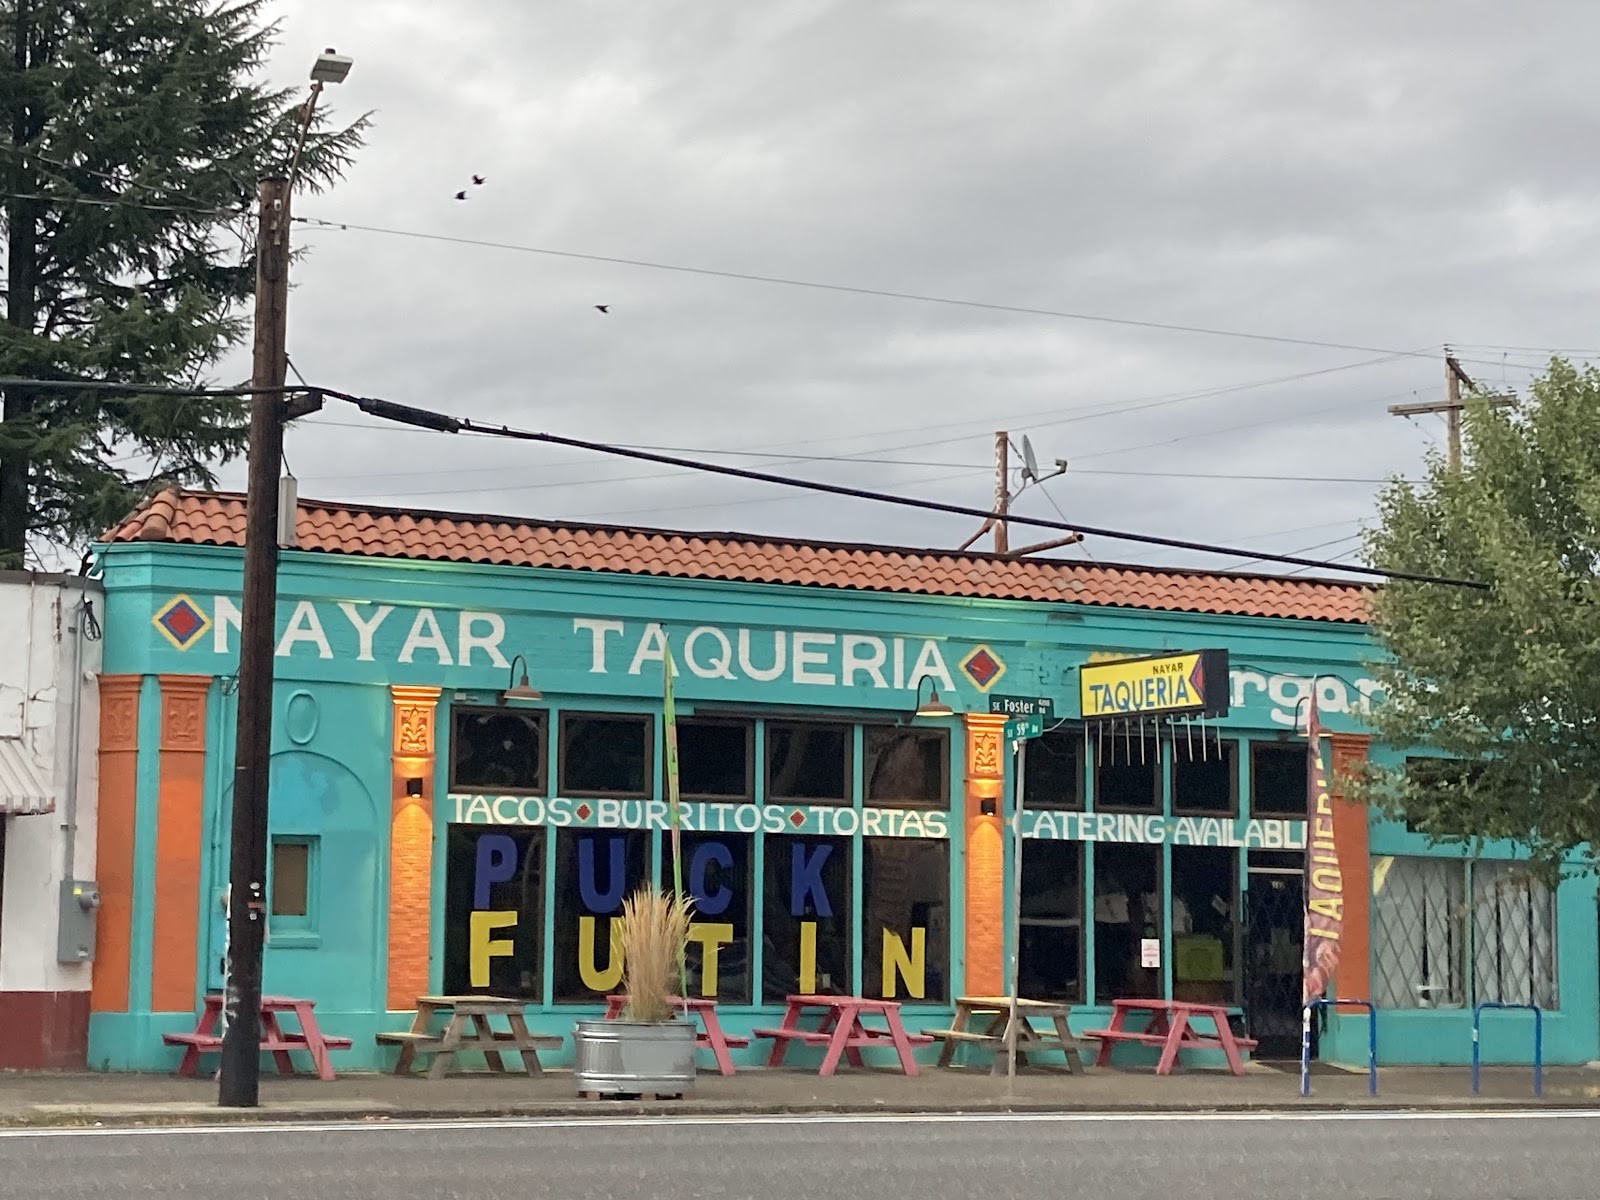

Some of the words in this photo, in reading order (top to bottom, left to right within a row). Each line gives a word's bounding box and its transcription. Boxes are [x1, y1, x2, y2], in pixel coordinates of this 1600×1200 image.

[214, 595, 511, 668] NAYAR
[573, 618, 956, 692] TAQUERIA
[1152, 662, 1184, 676] NAYAR
[992, 701, 1000, 711] SE
[1004, 699, 1034, 714] Foster
[1089, 675, 1190, 713] TAQUERIA
[447, 794, 572, 827] TACOS
[597, 800, 786, 833] BURRITOS
[809, 806, 948, 839] TORTAS
[1012, 809, 1166, 844] CATERING
[1308, 757, 1344, 940] TAQUE
[474, 834, 833, 918] PUCK
[469, 910, 925, 999] FUTIN
